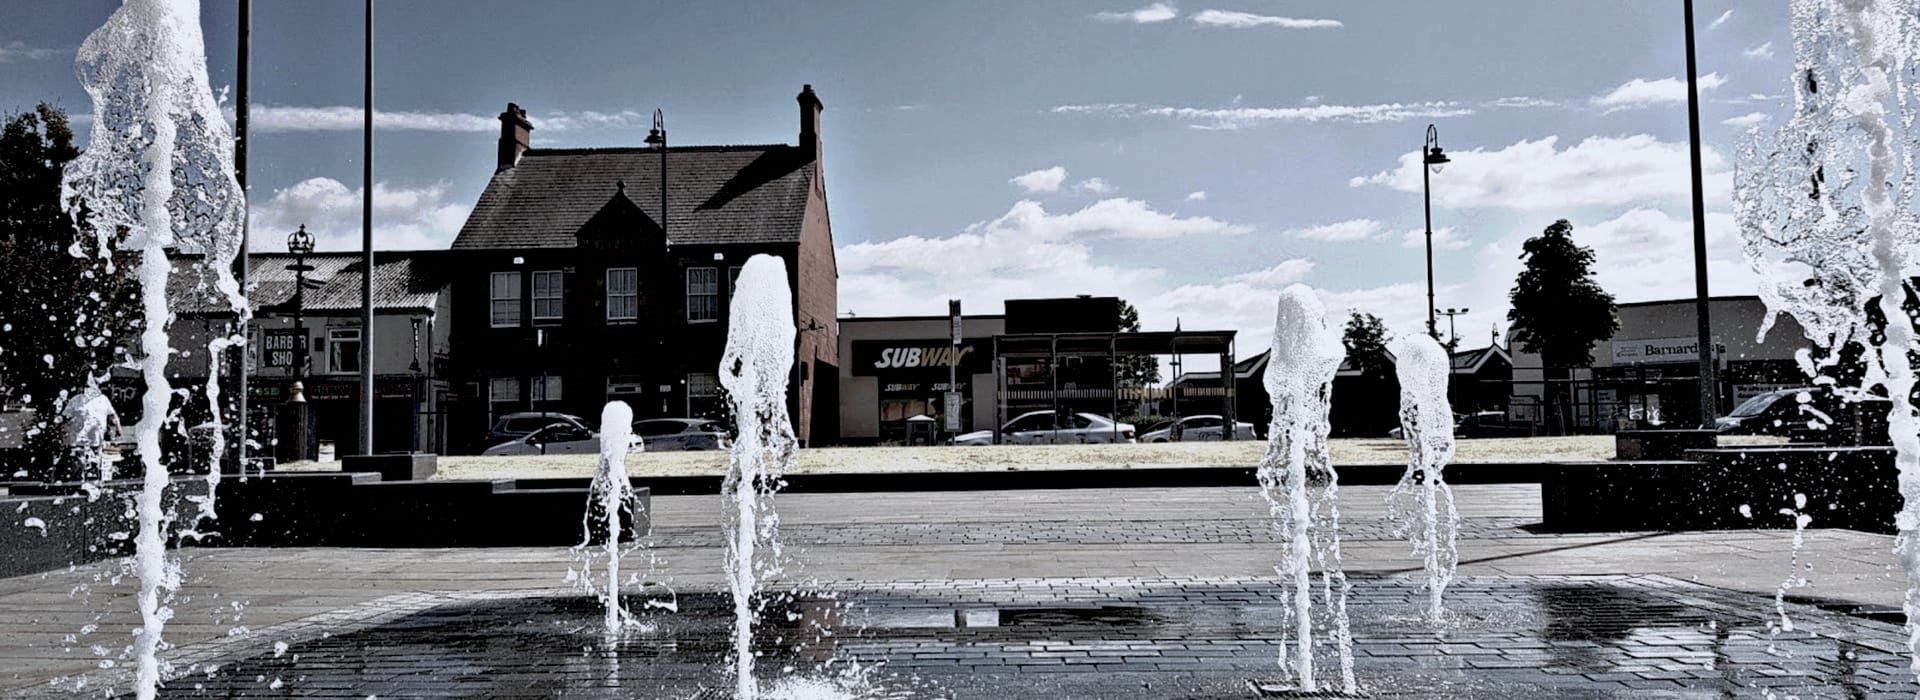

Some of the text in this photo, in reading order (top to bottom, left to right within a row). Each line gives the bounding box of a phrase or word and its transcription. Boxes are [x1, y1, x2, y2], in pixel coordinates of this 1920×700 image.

[266, 335, 307, 350] BARBR
[272, 351, 298, 366] SHO
[873, 345, 975, 369] SUBWAY
